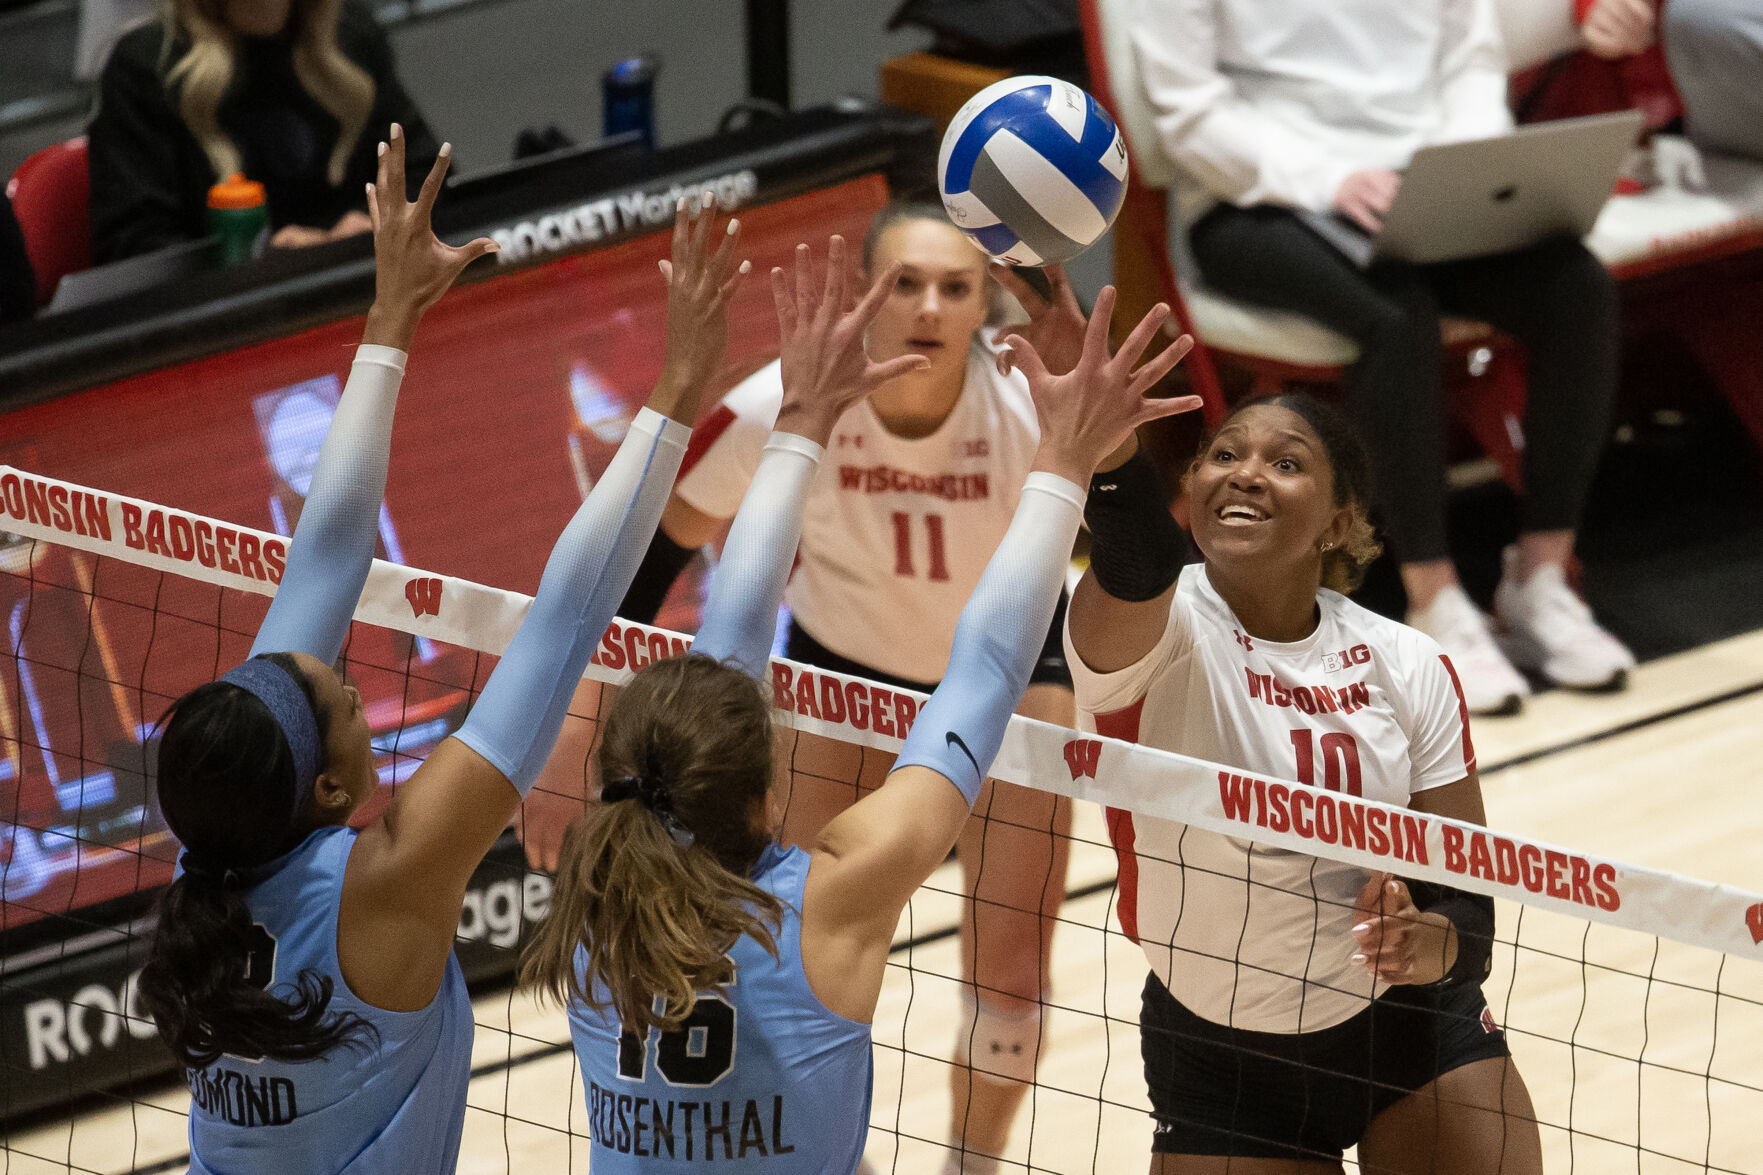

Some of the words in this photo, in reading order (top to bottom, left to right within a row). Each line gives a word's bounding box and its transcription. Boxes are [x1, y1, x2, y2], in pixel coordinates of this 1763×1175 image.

[838, 464, 990, 503] WISCONSIN
[0, 473, 112, 541] ONSIN
[121, 501, 286, 586] BADGERS
[892, 511, 950, 582] 11
[590, 622, 693, 673] SCO
[771, 661, 928, 741] BADGER
[1244, 666, 1371, 716] WISONIN
[1290, 728, 1363, 798] 10
[1218, 771, 1430, 866] WISCONSIN
[1441, 823, 1621, 912] BADGERS
[590, 1081, 796, 1161] ROSENTHAL
